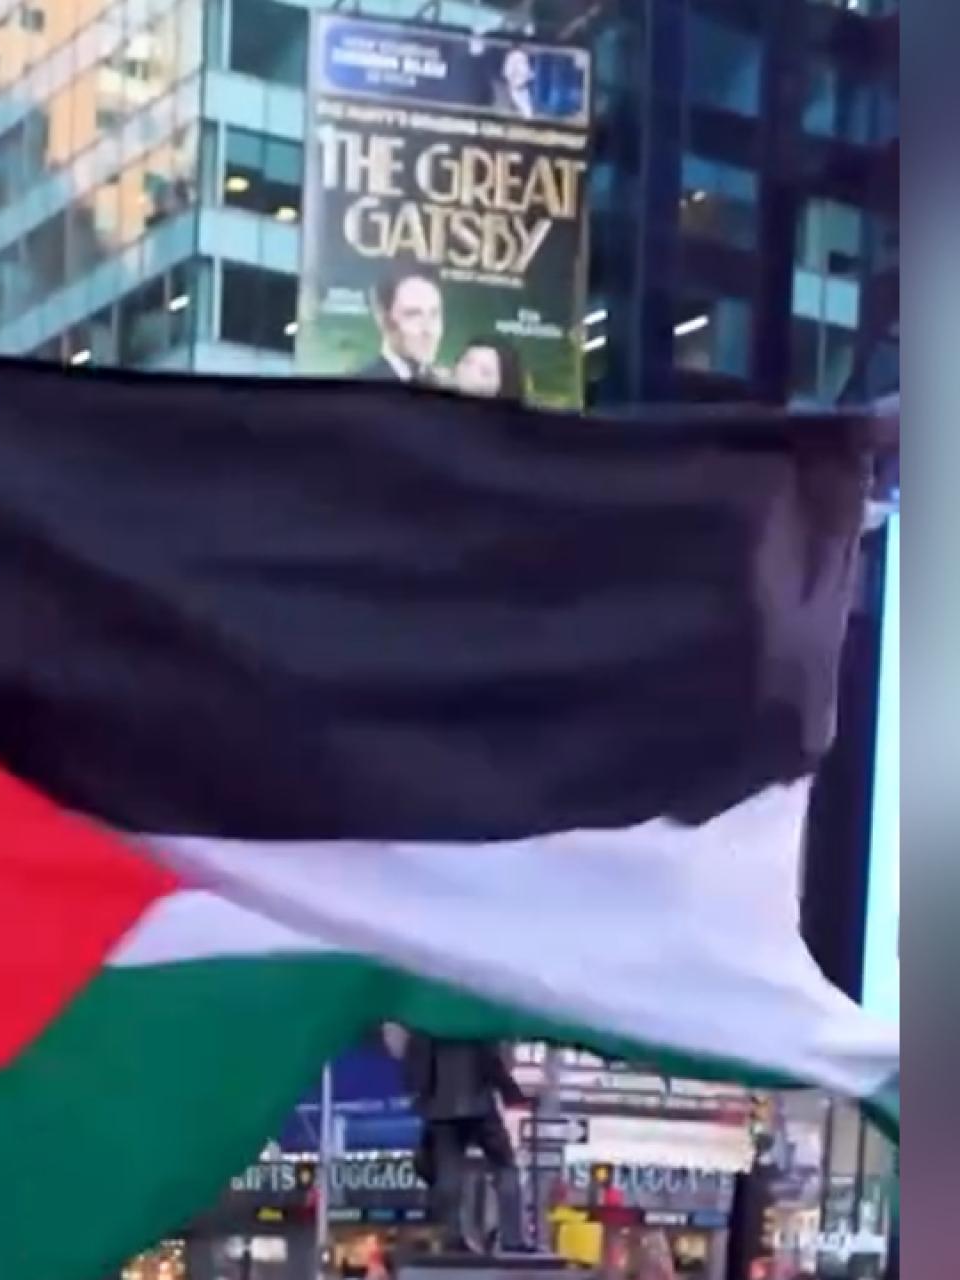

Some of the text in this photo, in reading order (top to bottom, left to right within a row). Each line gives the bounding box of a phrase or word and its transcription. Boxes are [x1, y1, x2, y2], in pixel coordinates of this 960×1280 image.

[319, 125, 405, 197] THE
[415, 142, 587, 219] GREAT
[343, 195, 553, 273] GATSBY
[330, 1160, 428, 1192] UGGAG
